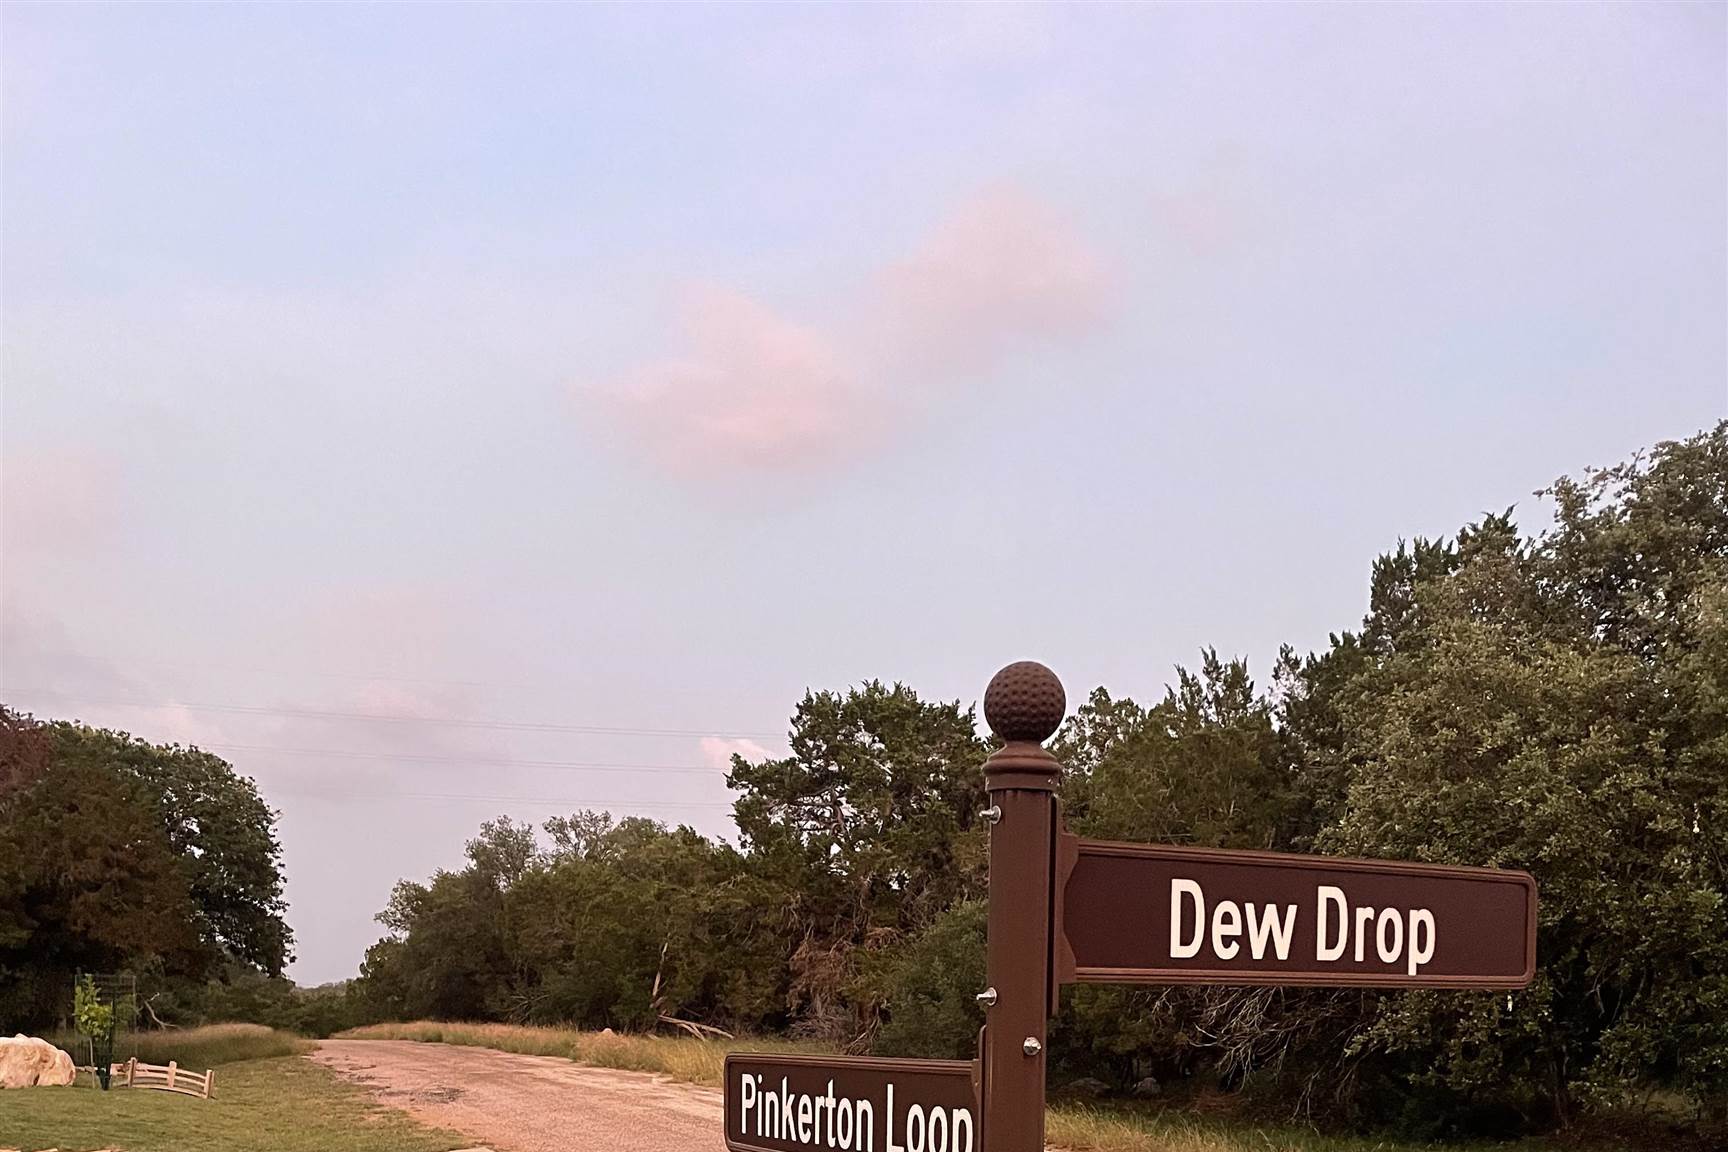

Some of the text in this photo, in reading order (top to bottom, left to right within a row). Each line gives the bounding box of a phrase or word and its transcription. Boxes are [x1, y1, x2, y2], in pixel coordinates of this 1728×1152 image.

[1170, 878, 1436, 976] Dew Drop
[741, 1073, 873, 1152] Pinkerton
